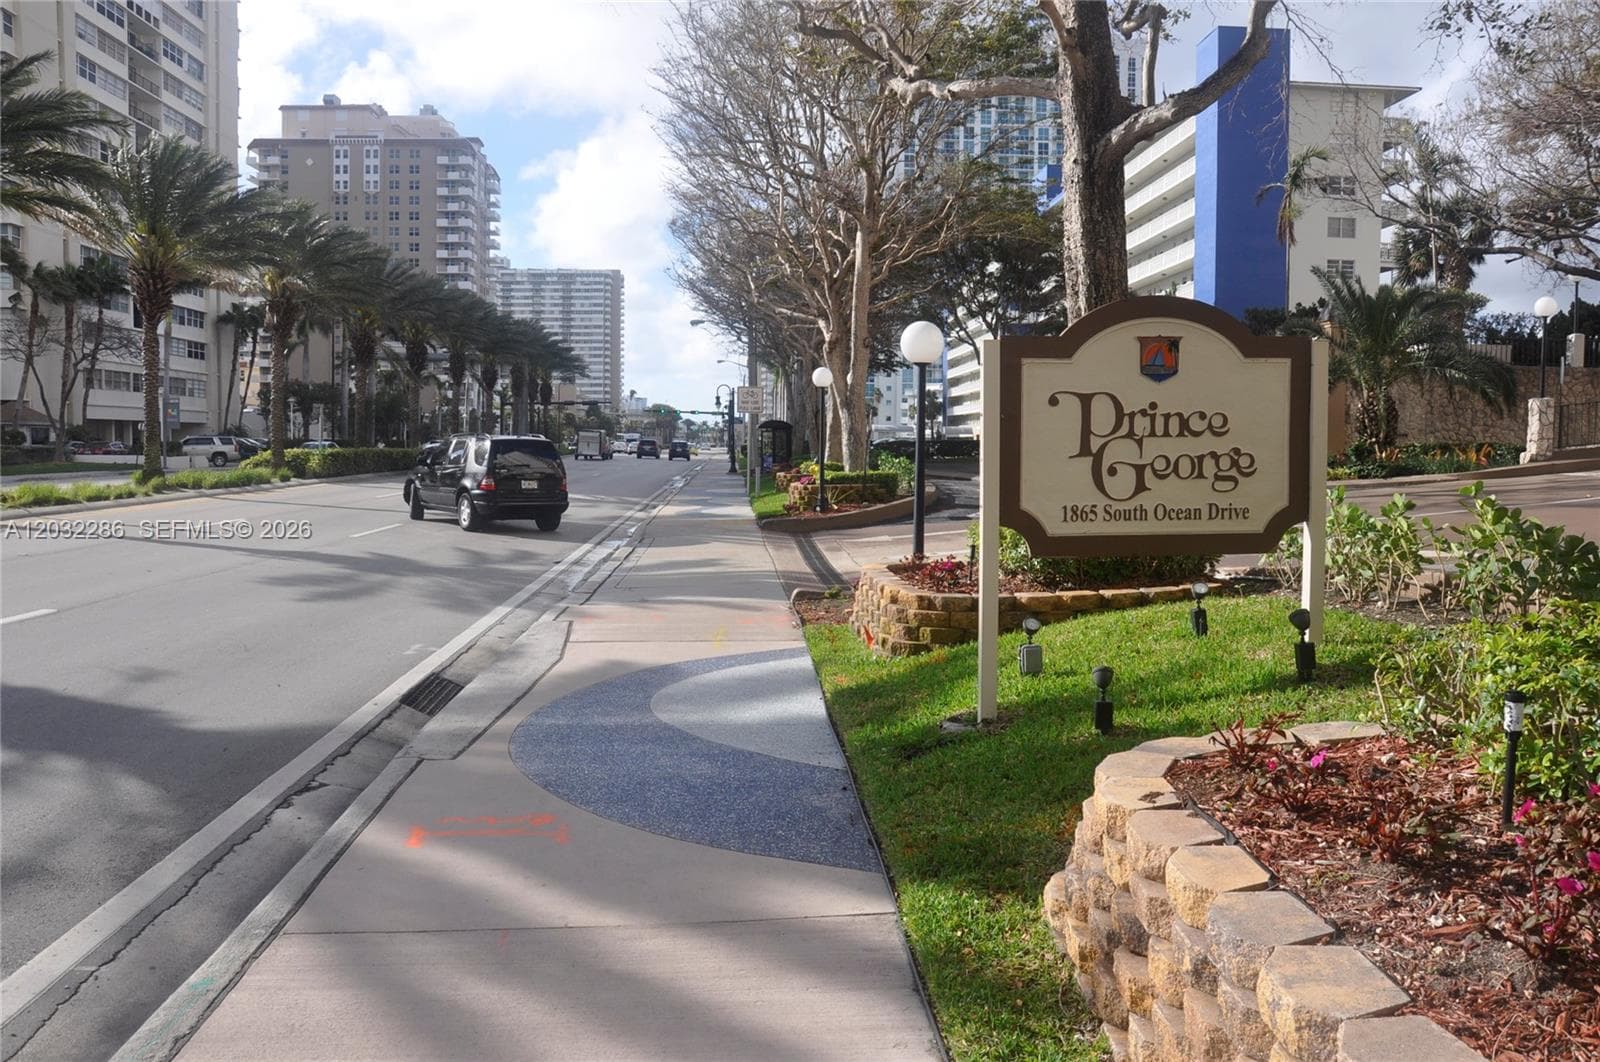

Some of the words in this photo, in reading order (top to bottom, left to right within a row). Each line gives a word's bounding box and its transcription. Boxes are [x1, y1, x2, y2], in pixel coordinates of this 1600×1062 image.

[1047, 390, 1231, 459] Prince
[1091, 429, 1258, 501] George
[1061, 504, 1098, 522] 1865
[1103, 503, 1149, 522] South
[1154, 503, 1202, 521] Ocean
[1207, 502, 1250, 520] Drive
